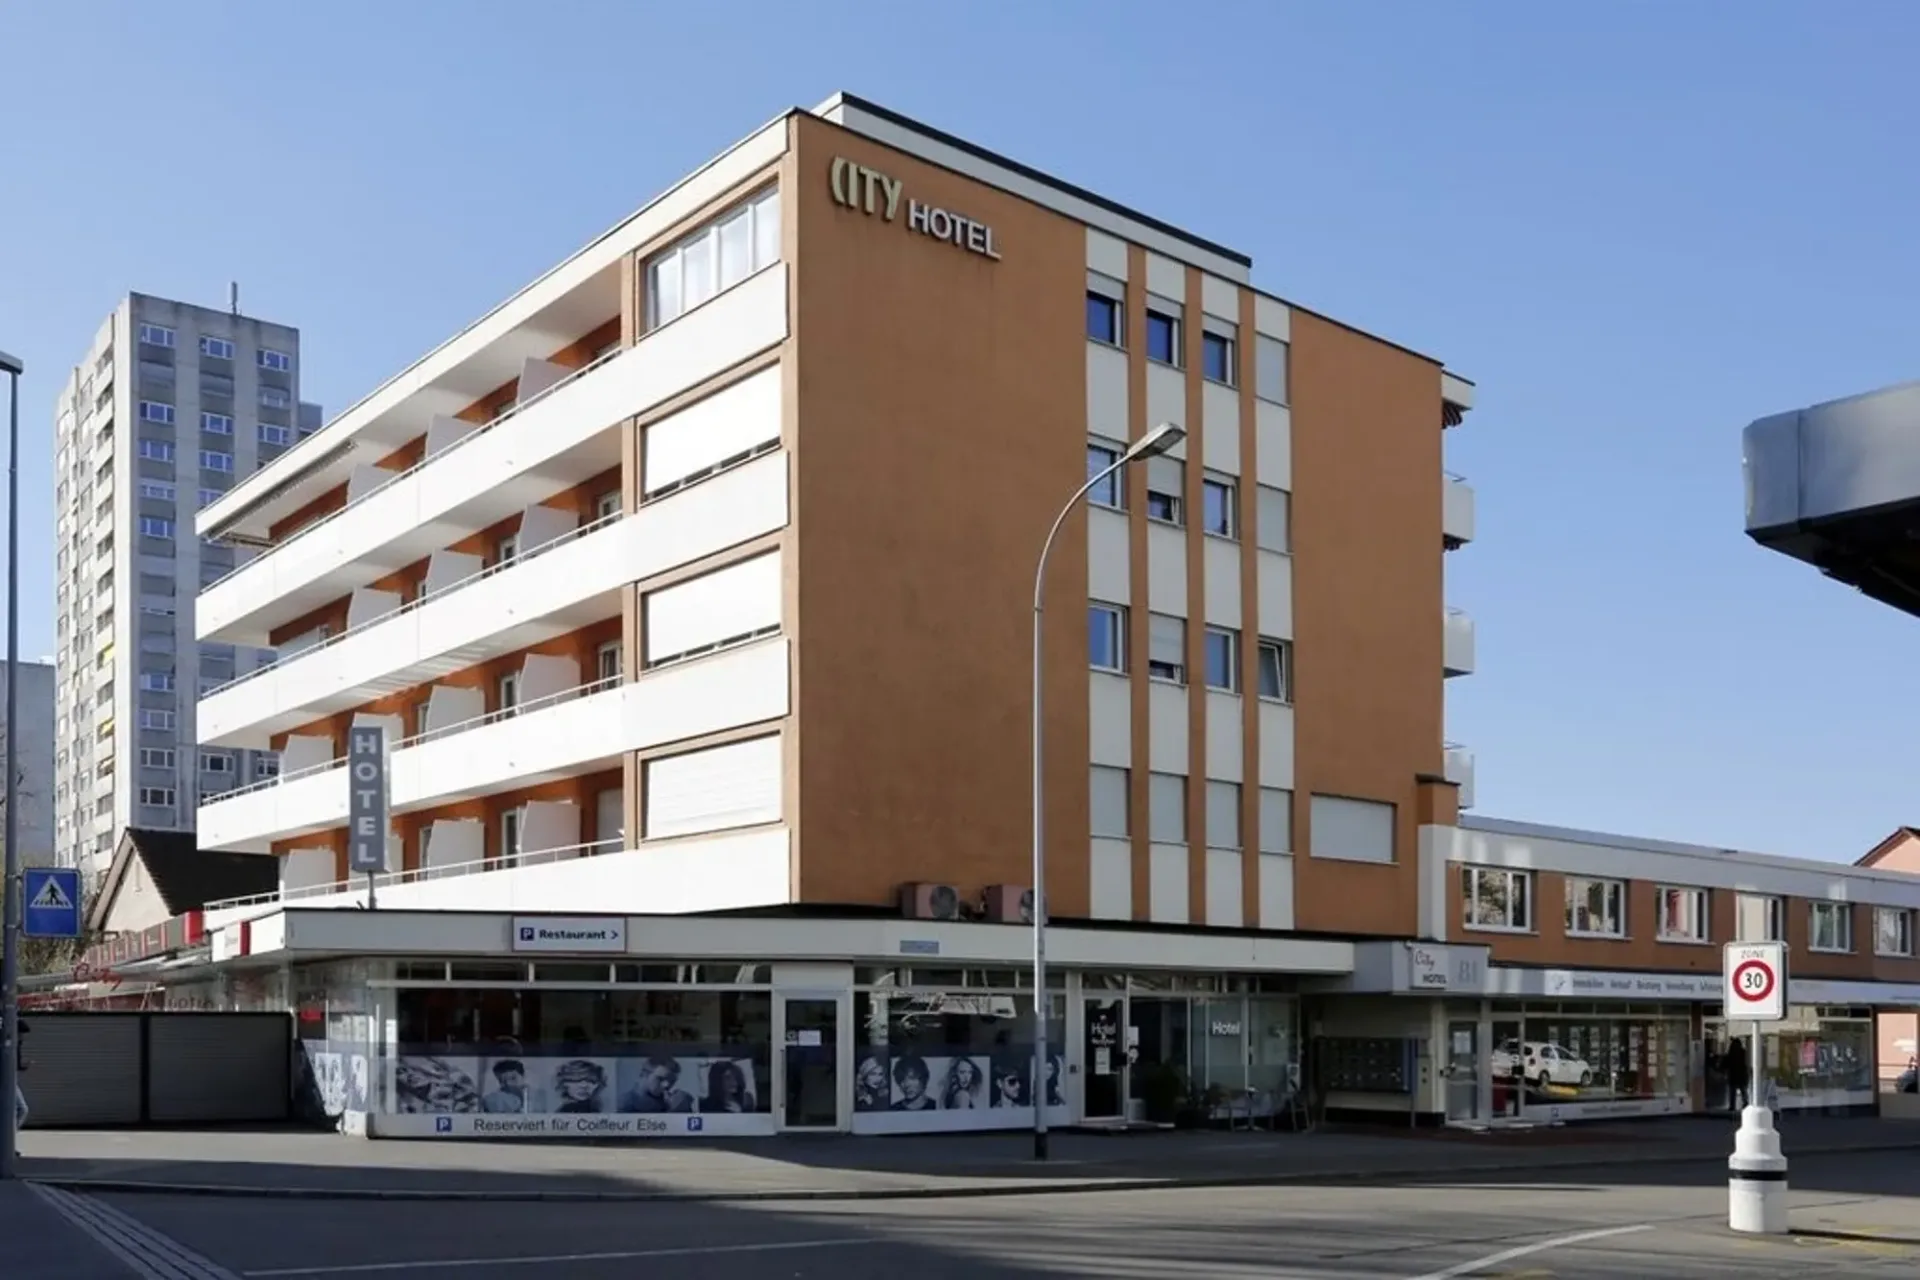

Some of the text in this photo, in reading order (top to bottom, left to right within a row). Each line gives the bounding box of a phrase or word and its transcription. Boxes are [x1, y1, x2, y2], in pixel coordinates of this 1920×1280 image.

[831, 155, 1002, 260] CITY HOTEL
[355, 734, 378, 864] HOTEL
[539, 929, 607, 940] Restaurant
[1741, 948, 1765, 959] ZONE
[1423, 974, 1447, 984] HOTEL
[1744, 972, 1764, 989] 30
[1212, 1021, 1241, 1035] Hotel
[473, 1118, 545, 1131] Reserviert
[551, 1118, 570, 1131] für
[576, 1118, 630, 1131] Coiffeur
[636, 1118, 668, 1131] Else
